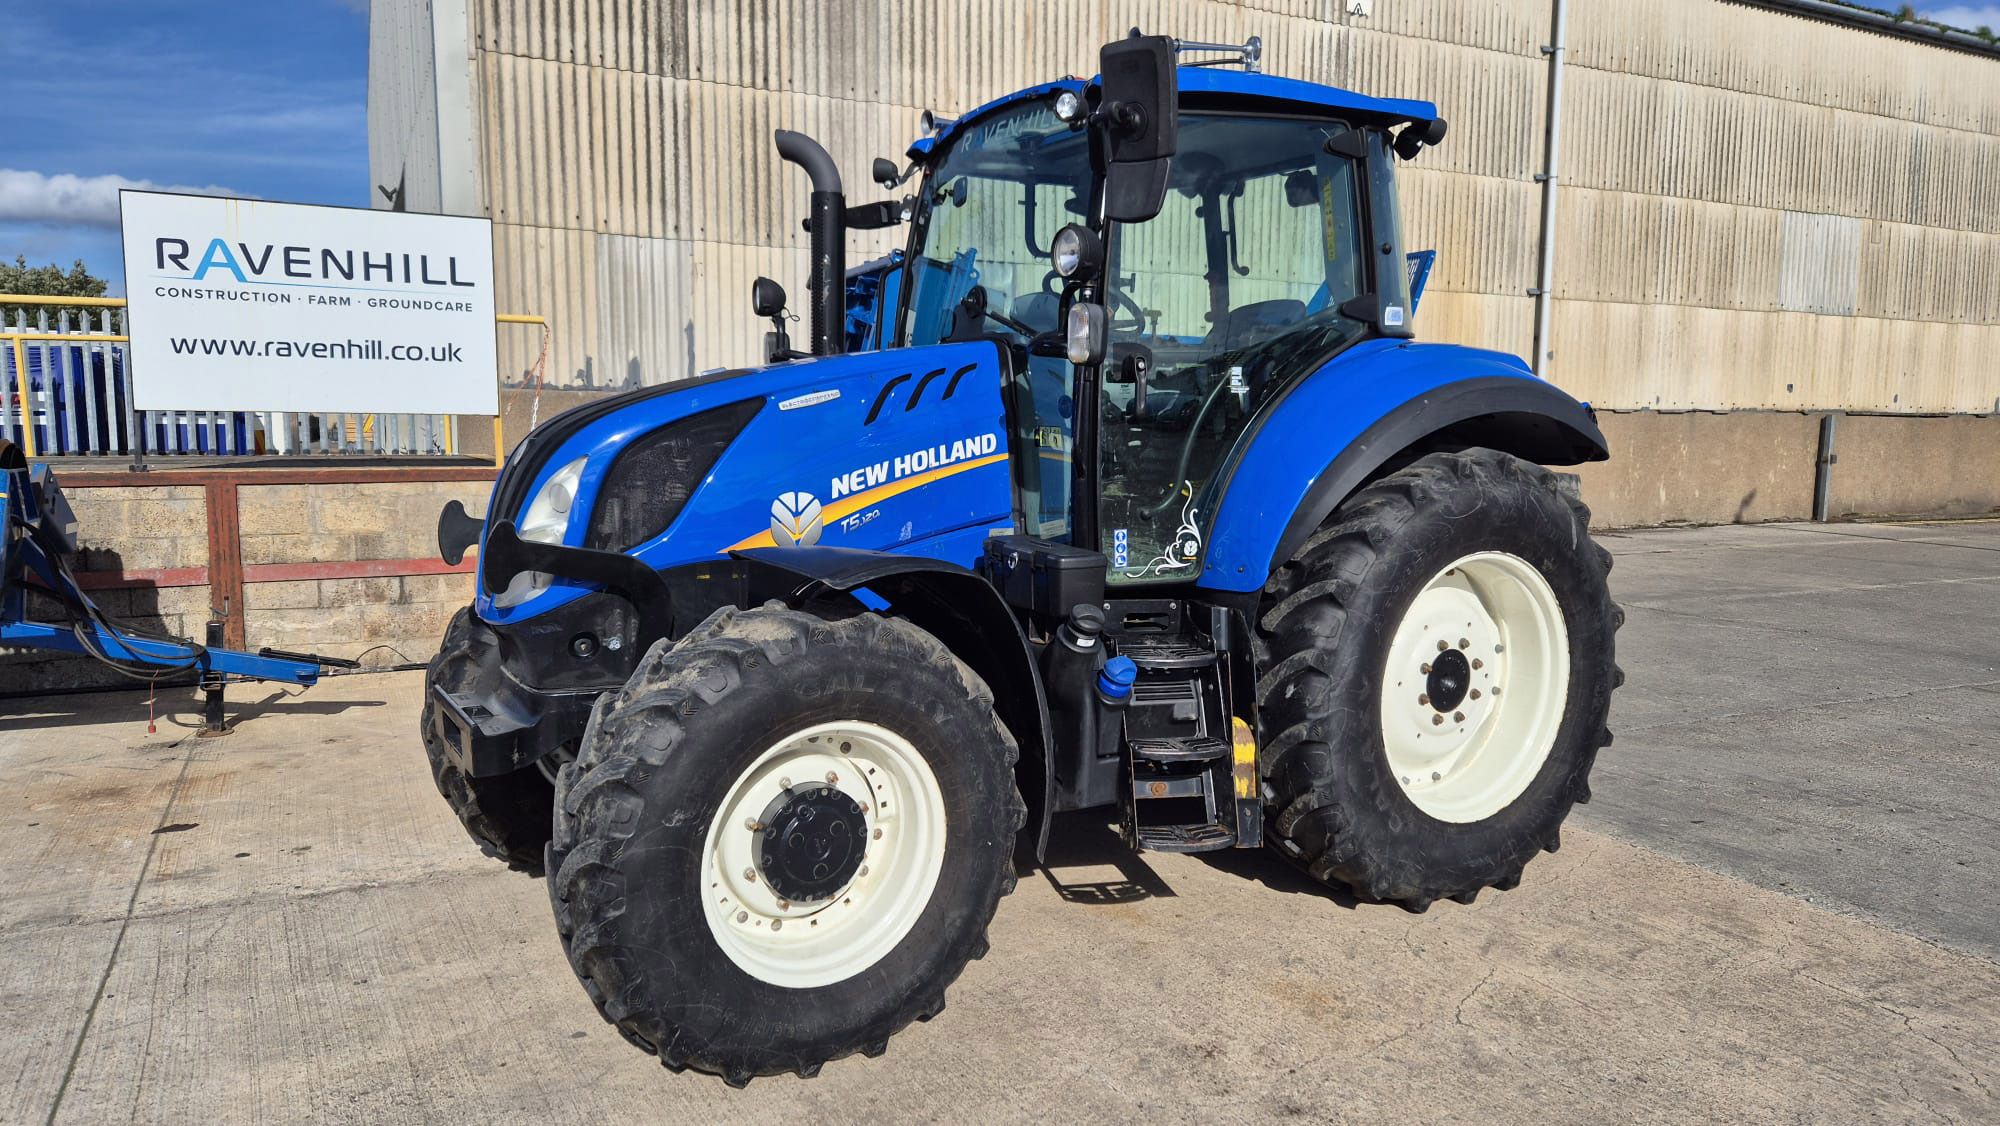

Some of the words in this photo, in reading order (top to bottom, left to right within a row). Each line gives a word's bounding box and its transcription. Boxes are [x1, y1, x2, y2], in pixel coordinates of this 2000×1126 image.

[155, 237, 475, 288] RAVENHILL
[155, 287, 291, 304] CONSTRUCTION
[308, 294, 352, 307] FARM
[367, 298, 474, 313] GROUNDCARE
[170, 336, 464, 363] www.ravenhill.co.uk
[831, 461, 889, 499] NEW
[894, 432, 997, 478] HOLLAND
